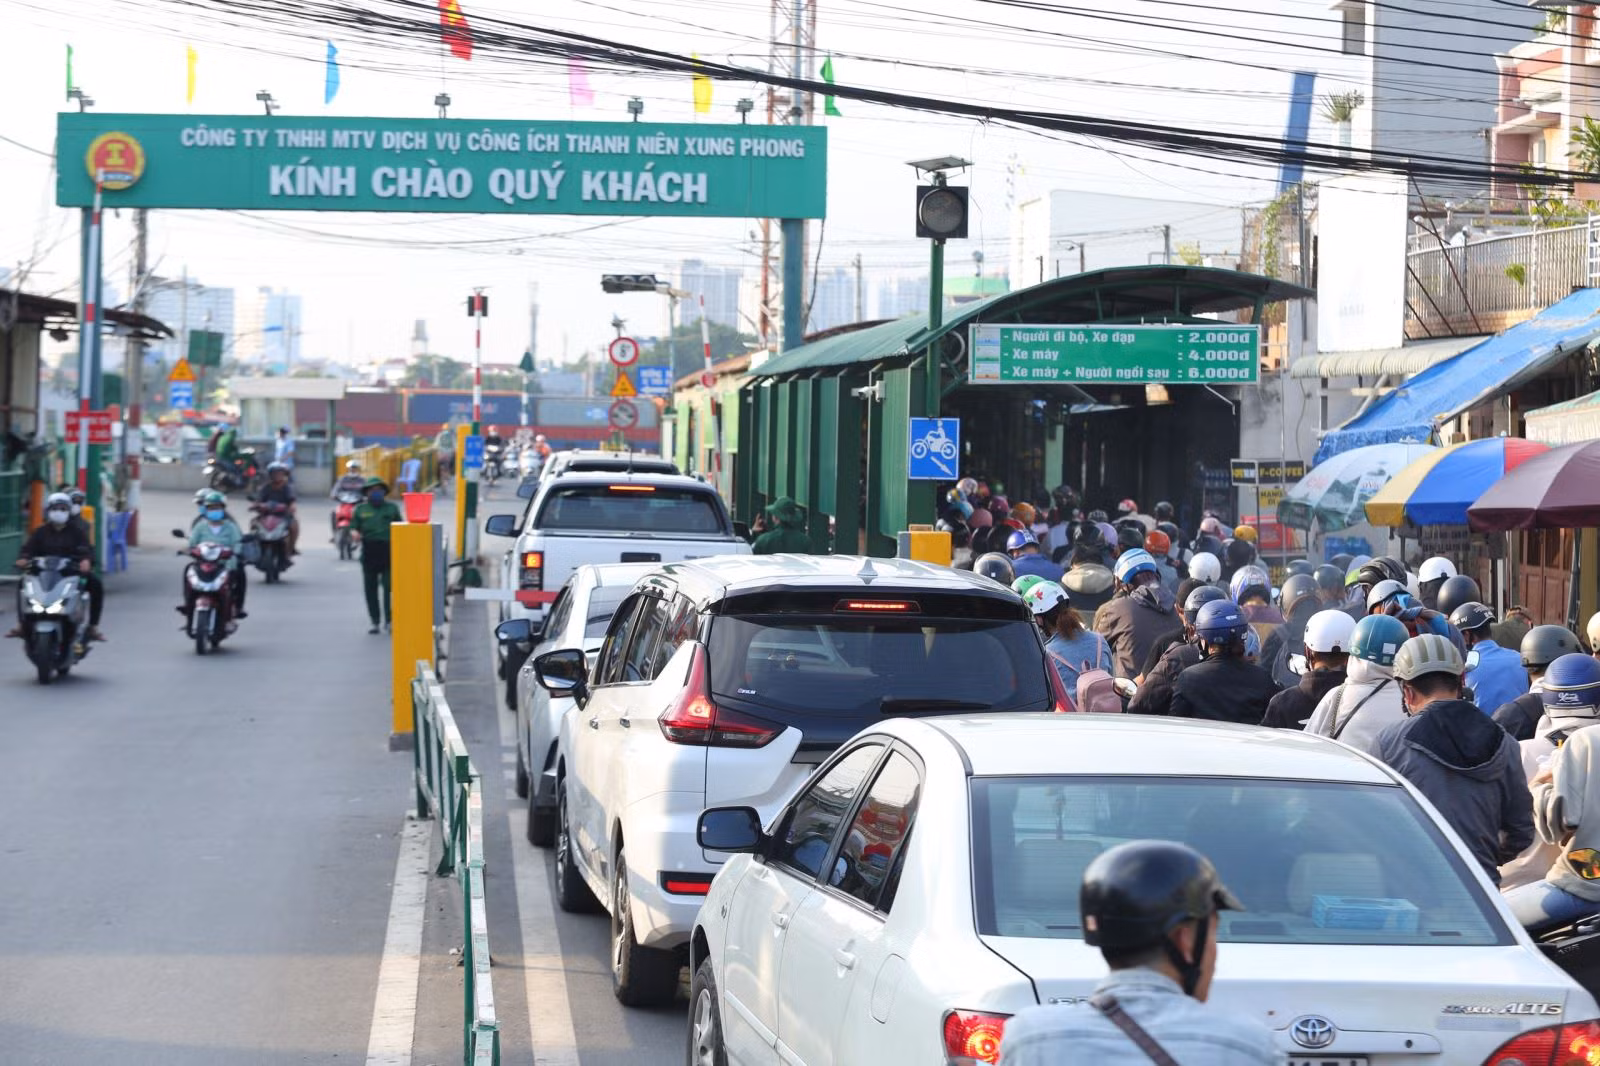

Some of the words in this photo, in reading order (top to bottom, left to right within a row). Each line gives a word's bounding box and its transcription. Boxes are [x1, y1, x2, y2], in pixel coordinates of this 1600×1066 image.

[181, 123, 235, 147] CÔNG
[243, 129, 268, 147] TY
[275, 129, 327, 148] TNHH
[332, 130, 376, 149] MTV
[382, 131, 428, 154] DỊCH
[435, 132, 460, 155] VỤ
[467, 128, 520, 152] CÔNG
[527, 128, 560, 152] ÍCH
[565, 133, 630, 154] THANH
[636, 132, 679, 155] NIÊN
[684, 137, 735, 156] XUNG
[740, 137, 805, 158] PHONG
[269, 156, 356, 197] KÍNH
[371, 159, 474, 199] CHÀO
[488, 160, 566, 205] QUÝ
[581, 162, 708, 204] KHÁCH
[1012, 330, 1049, 343] Người
[1053, 330, 1065, 343] đi
[1069, 331, 1089, 345] bộ,
[1092, 331, 1108, 343] Xe
[1112, 331, 1136, 345] đạp
[1188, 332, 1250, 344] 2.000đ
[1012, 348, 1029, 360] Xe
[1032, 348, 1059, 361] máy
[1188, 350, 1250, 361] 4.000đ
[1012, 365, 1028, 377] Xe
[1032, 365, 1059, 379] máy
[1075, 365, 1112, 379] Người
[1116, 365, 1144, 379] ngồi
[1147, 367, 1170, 378] sau
[1188, 367, 1250, 379] 6.000đ
[1499, 1002, 1563, 1015] ALTIS
